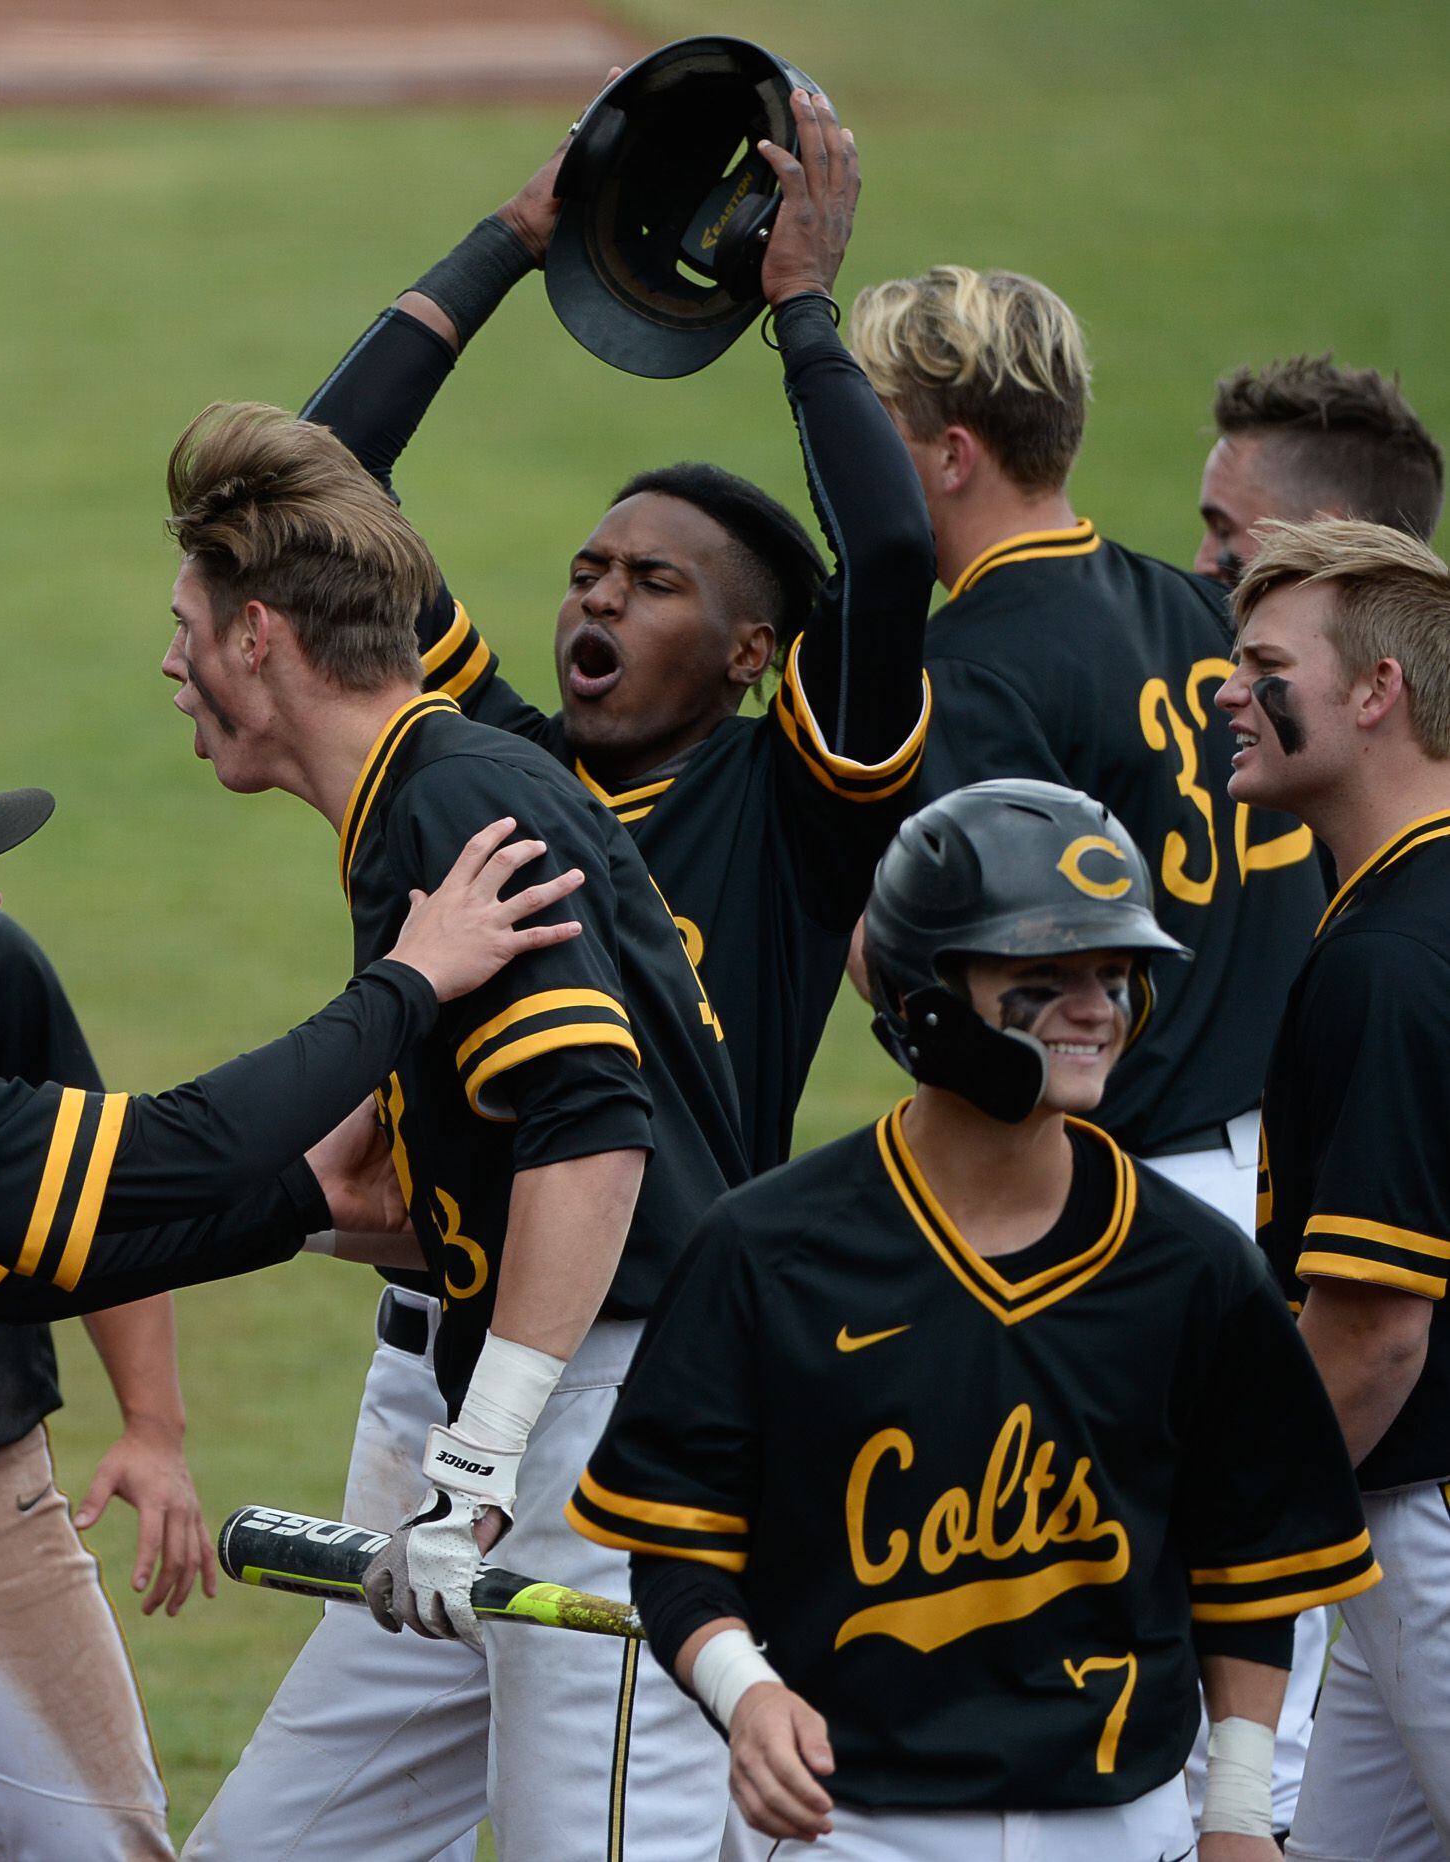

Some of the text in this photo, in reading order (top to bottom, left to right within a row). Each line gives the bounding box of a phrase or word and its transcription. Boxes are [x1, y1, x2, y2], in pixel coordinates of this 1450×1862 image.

[1056, 835, 1133, 899] C
[435, 1450, 495, 1477] FORCE
[844, 1403, 1130, 1590] Colts
[1063, 1651, 1138, 1774] 7
